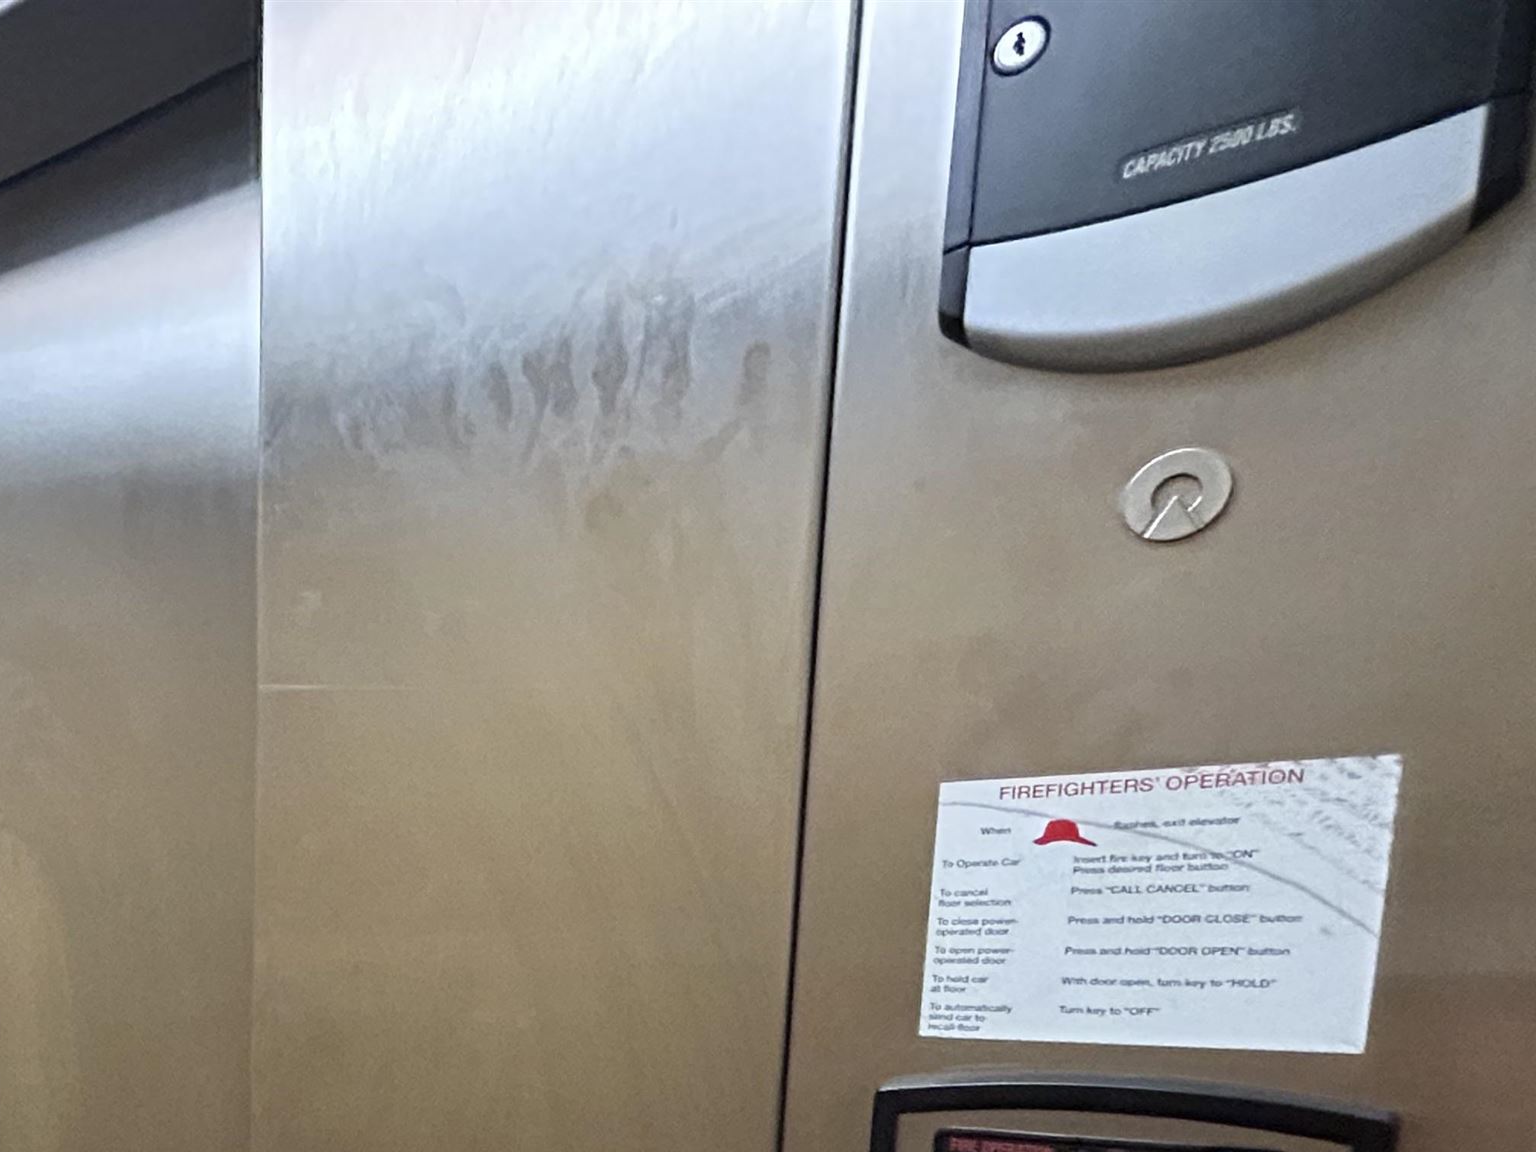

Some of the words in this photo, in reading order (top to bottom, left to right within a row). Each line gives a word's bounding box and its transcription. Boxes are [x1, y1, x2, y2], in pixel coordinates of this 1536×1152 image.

[1122, 139, 1208, 179] CAPACITY
[1208, 124, 1254, 154] 2500
[1255, 113, 1297, 141] LBS.
[999, 777, 1161, 800] FIREFIGHTERS'
[1165, 768, 1306, 791] OPERATION
[1189, 817, 1241, 827] elevator
[980, 827, 1012, 835] When
[1073, 855, 1106, 864] Insert
[1109, 854, 1128, 863] fire
[1131, 854, 1151, 864] key
[1156, 852, 1179, 861] and
[1182, 852, 1208, 861] turn
[942, 860, 954, 868] To
[956, 859, 999, 869] Operate
[1001, 858, 1021, 866] Car
[1072, 865, 1105, 875] Press
[1108, 864, 1152, 874] desired
[1155, 863, 1186, 873] floor
[1187, 863, 1229, 872] button
[940, 888, 952, 897] To
[953, 888, 989, 897] cancel
[1070, 886, 1103, 895] Press
[1105, 885, 1142, 894] "CALL
[1145, 884, 1206, 893] CANCEL"
[1207, 884, 1251, 893] button
[964, 899, 1012, 907] selection
[936, 917, 949, 926] To
[951, 915, 979, 926] close
[1067, 915, 1100, 925] Press
[1102, 915, 1125, 924] and
[1127, 915, 1154, 924] hold
[1156, 915, 1201, 924] "DOOR
[1204, 914, 1257, 923] CLOSE"
[1259, 914, 1303, 923] button
[935, 928, 982, 937] operated
[984, 928, 1010, 936] door
[934, 946, 946, 954] To
[1064, 946, 1097, 956] Press
[1099, 946, 1122, 956] and
[1124, 946, 1151, 956] hold
[1152, 946, 1198, 956] "DOOR
[1201, 946, 1246, 956] OPEN"
[1247, 946, 1291, 956] button
[932, 957, 980, 965] operated
[981, 957, 1007, 965] door
[932, 974, 944, 983] To
[946, 975, 969, 984] hold
[971, 976, 989, 984] car
[1061, 976, 1087, 986] With
[1090, 977, 1117, 986] door
[1119, 978, 1153, 989] open,
[1157, 977, 1181, 987] turn
[1184, 978, 1206, 989] key
[1210, 978, 1223, 987] to
[1225, 977, 1278, 988] "HOLD"
[930, 985, 941, 993] at
[943, 985, 967, 993] floor
[930, 1002, 942, 1011] To
[944, 1004, 1013, 1014] automatically
[1059, 1005, 1085, 1015] Turn
[1086, 1006, 1107, 1017] key
[1109, 1006, 1122, 1016] to
[1123, 1006, 1161, 1016] "OFF"
[928, 1013, 954, 1021] send
[975, 1014, 986, 1022] to
